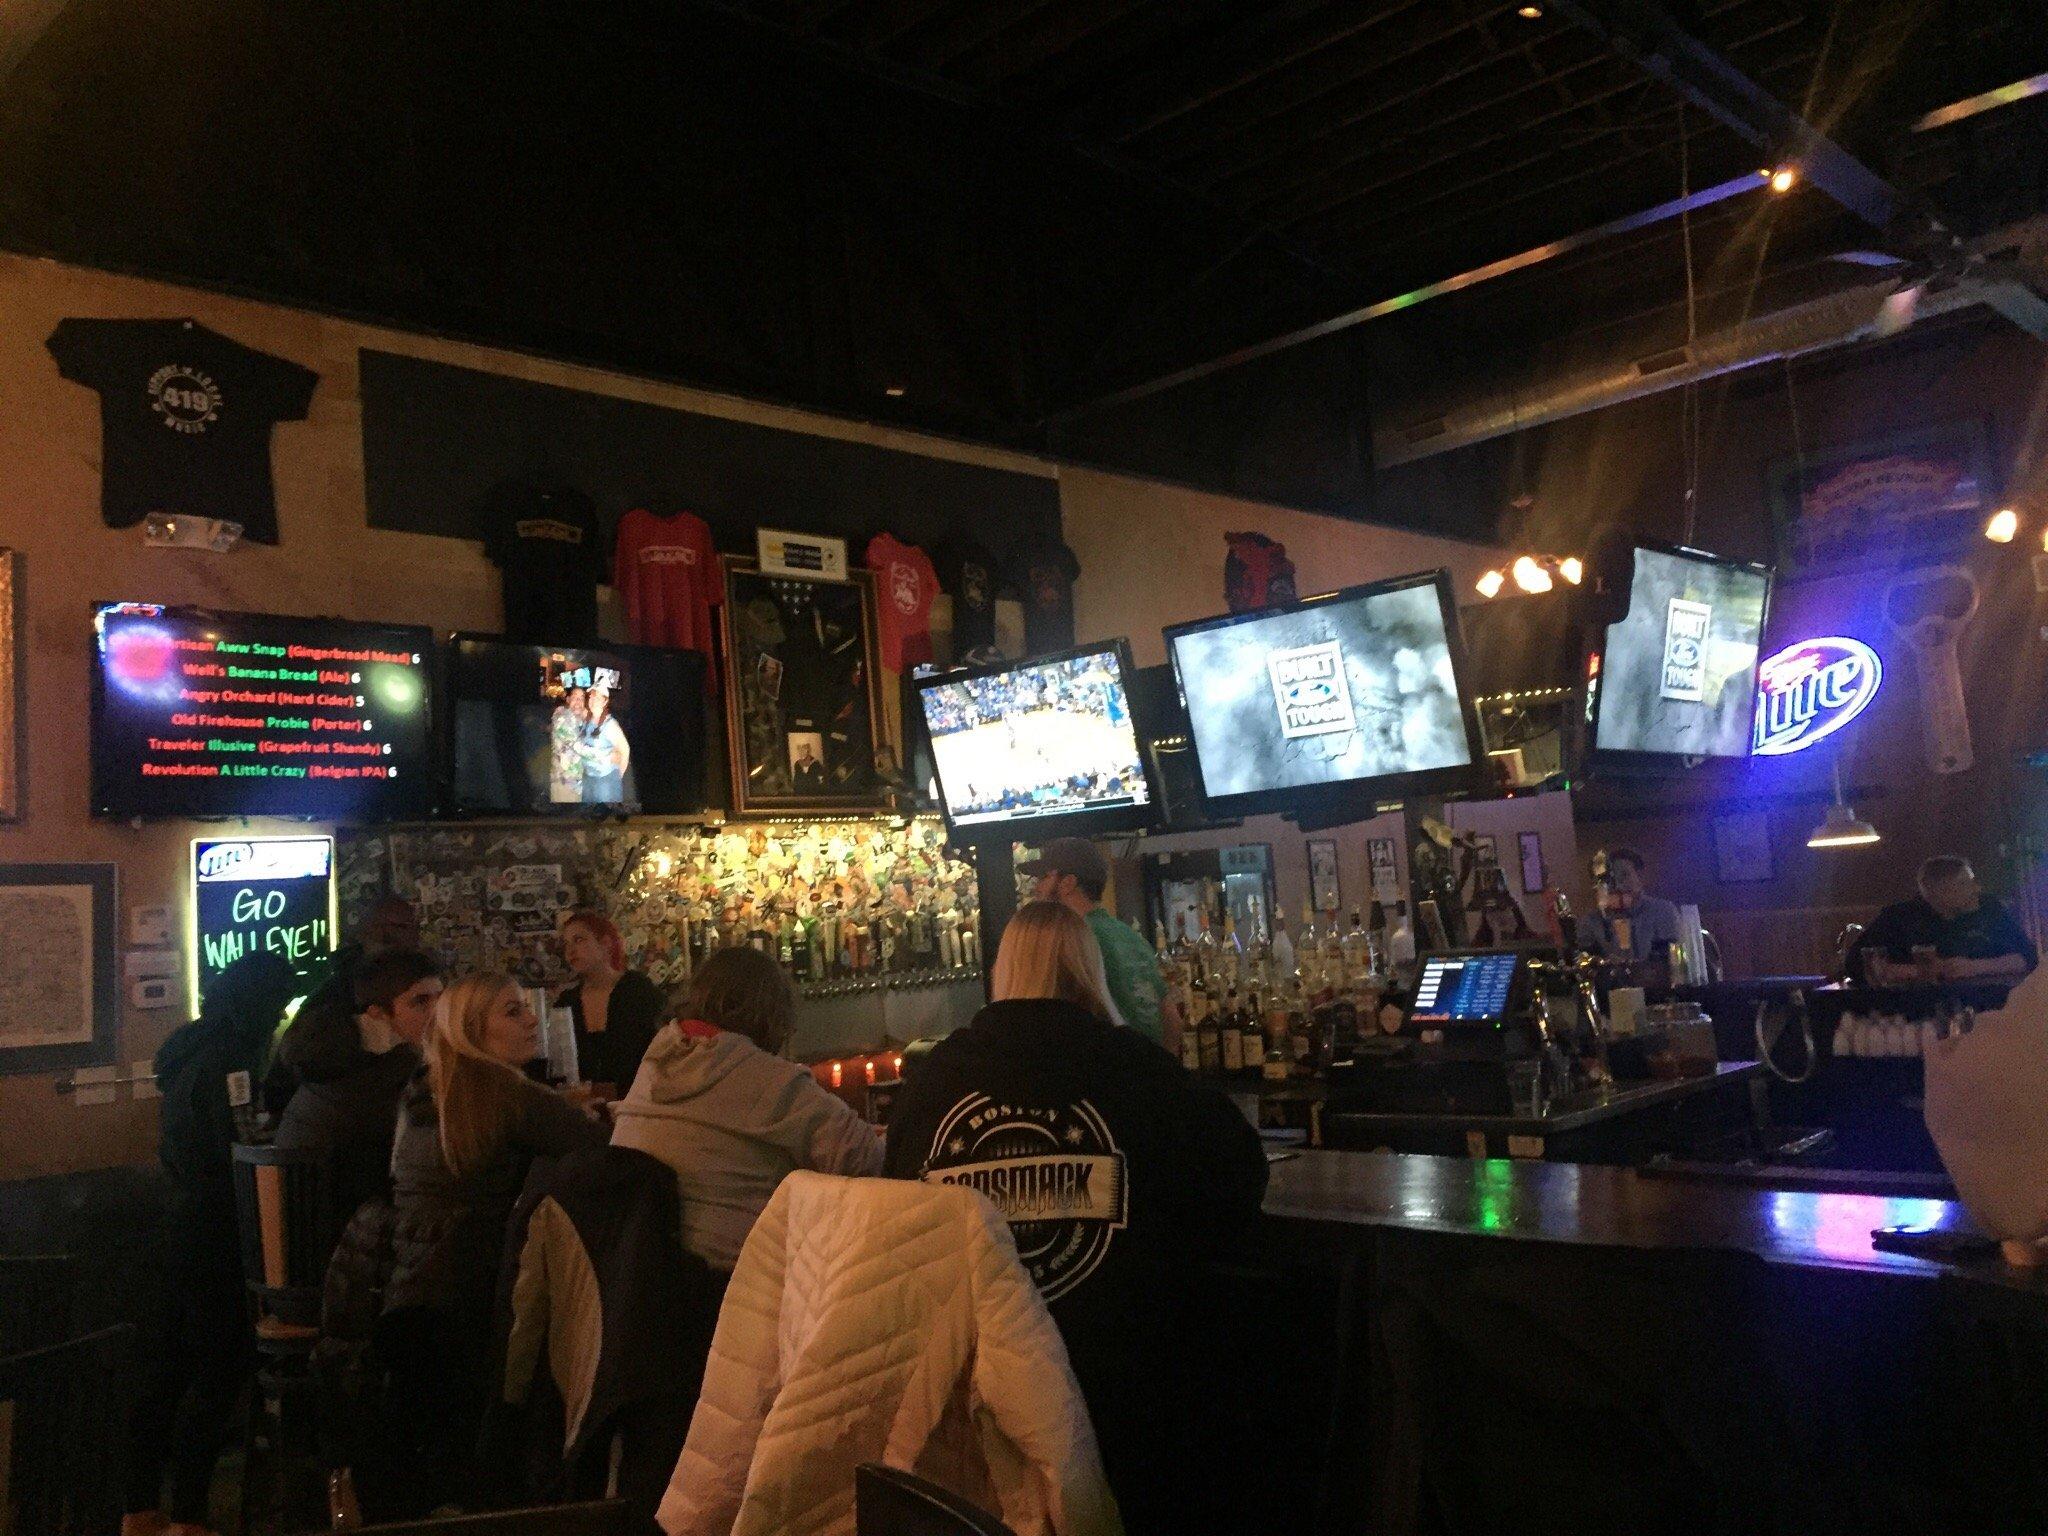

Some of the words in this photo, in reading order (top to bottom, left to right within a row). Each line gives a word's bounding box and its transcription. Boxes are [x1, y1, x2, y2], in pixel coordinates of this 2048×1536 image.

[216, 641, 250, 653] Aww
[253, 644, 286, 657] Snap
[288, 645, 370, 662] (Gingerbread
[412, 654, 420, 664] 6
[228, 666, 277, 679] Banana
[279, 669, 317, 681] Bread
[319, 671, 350, 684] (Ale)
[351, 673, 361, 683] 6
[179, 688, 219, 704] Angry
[222, 690, 276, 703] Orchard
[278, 692, 314, 705] (Hard
[316, 694, 355, 708] Cider)
[355, 696, 365, 707] 5
[171, 713, 197, 726] Old
[199, 714, 264, 727] Firehouse
[267, 717, 309, 729] Probie
[312, 718, 361, 732] (Porter)
[363, 720, 372, 731] 6
[1286, 702, 1346, 729] TOUGH
[148, 738, 205, 750] Traveler
[208, 739, 256, 751] Illusive
[259, 741, 329, 754] (Grapefruit
[332, 742, 381, 755] Shandy)
[383, 744, 391, 754] 6
[142, 764, 218, 775] Revolution
[220, 765, 231, 775] A
[234, 765, 268, 776] Little
[271, 765, 306, 778] Crazy
[309, 765, 359, 779] (Belgian
[388, 767, 397, 777] 6
[231, 887, 286, 923] GO
[968, 1103, 1060, 1130] BOSTON
